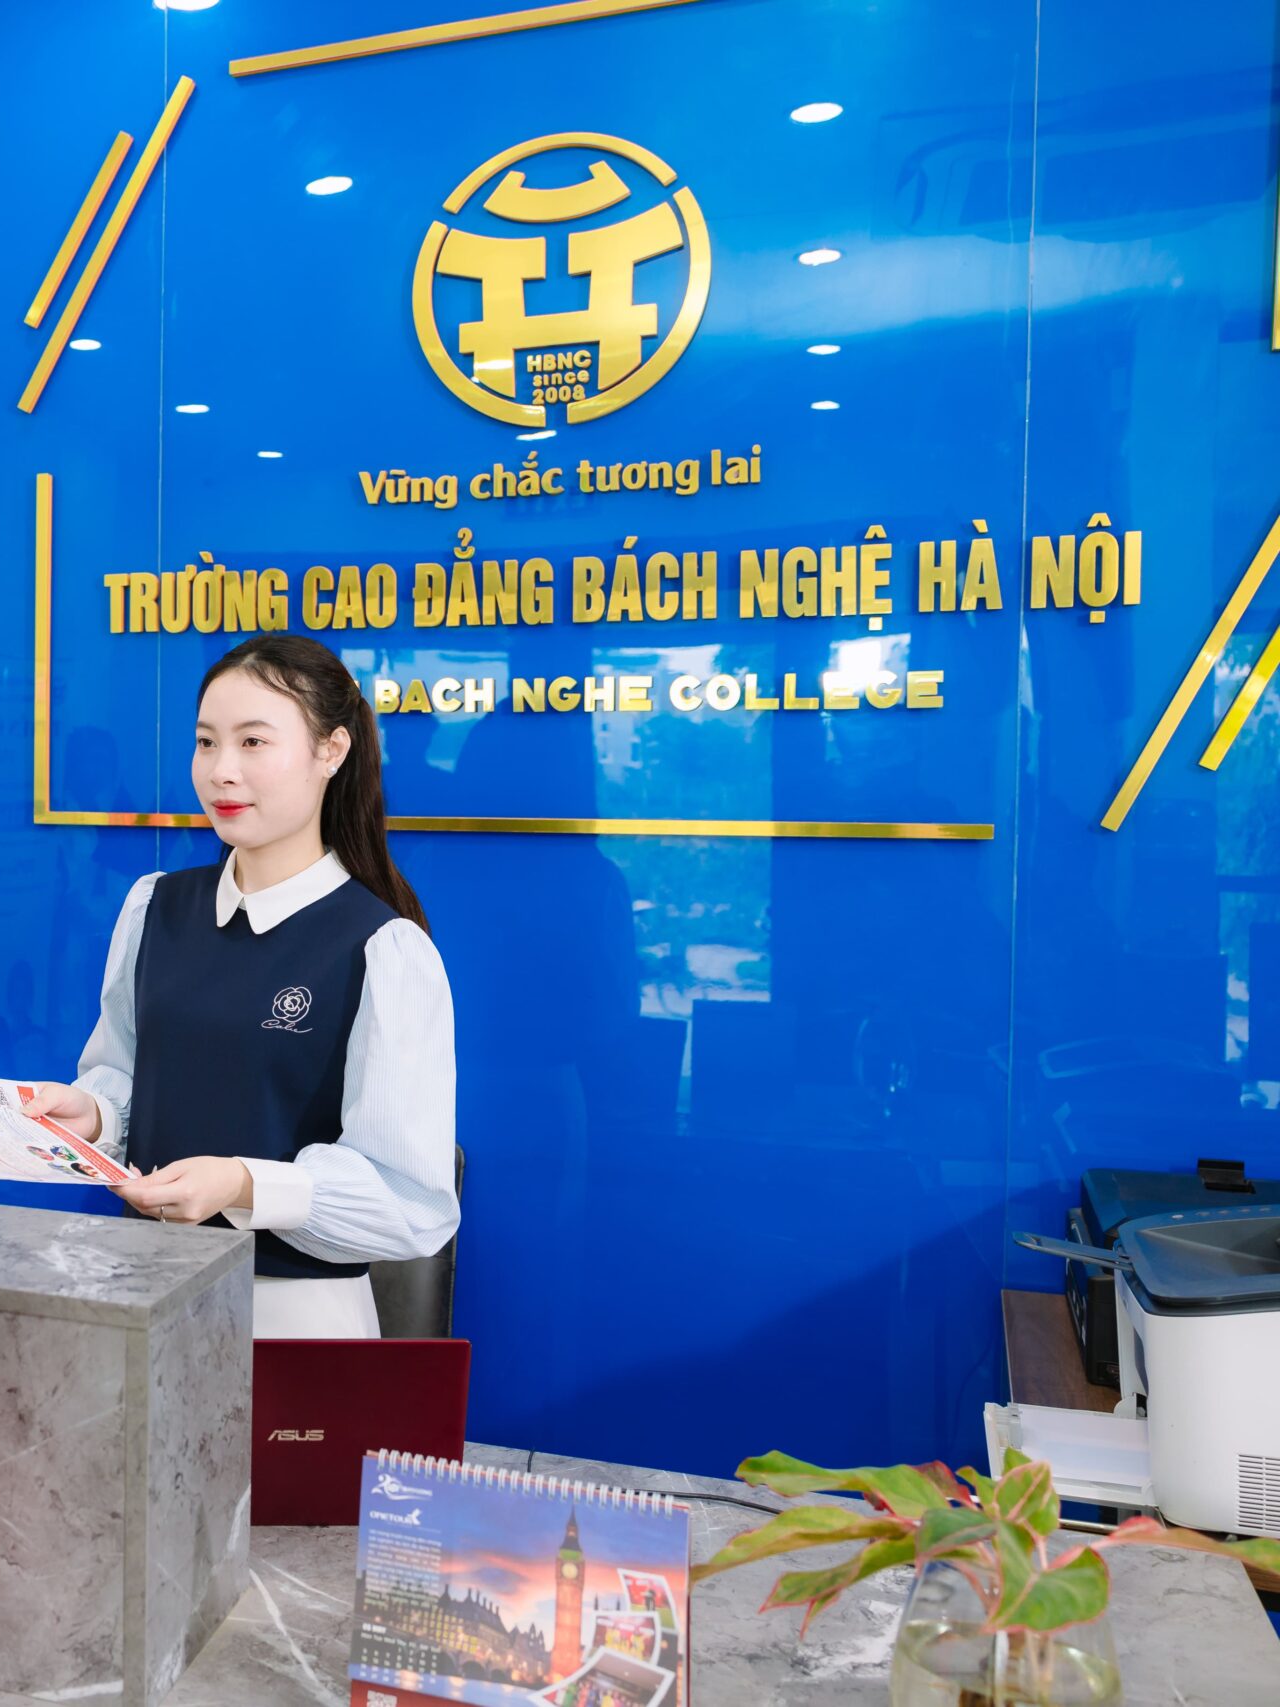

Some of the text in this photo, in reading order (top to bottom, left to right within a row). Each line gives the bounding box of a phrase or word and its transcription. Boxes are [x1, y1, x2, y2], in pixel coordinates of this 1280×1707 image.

[526, 350, 592, 373] HBNC
[532, 370, 590, 387] since
[532, 384, 586, 406] 2008
[359, 443, 762, 510] Vững chắc tương lai
[103, 512, 1143, 634] TRƯỜNG CAO ĐẲNG BÁCH NGHỆ HÀ NỘI
[375, 669, 945, 713] BACH NGHE COLLEGE
[267, 1429, 324, 1441] ASUS
